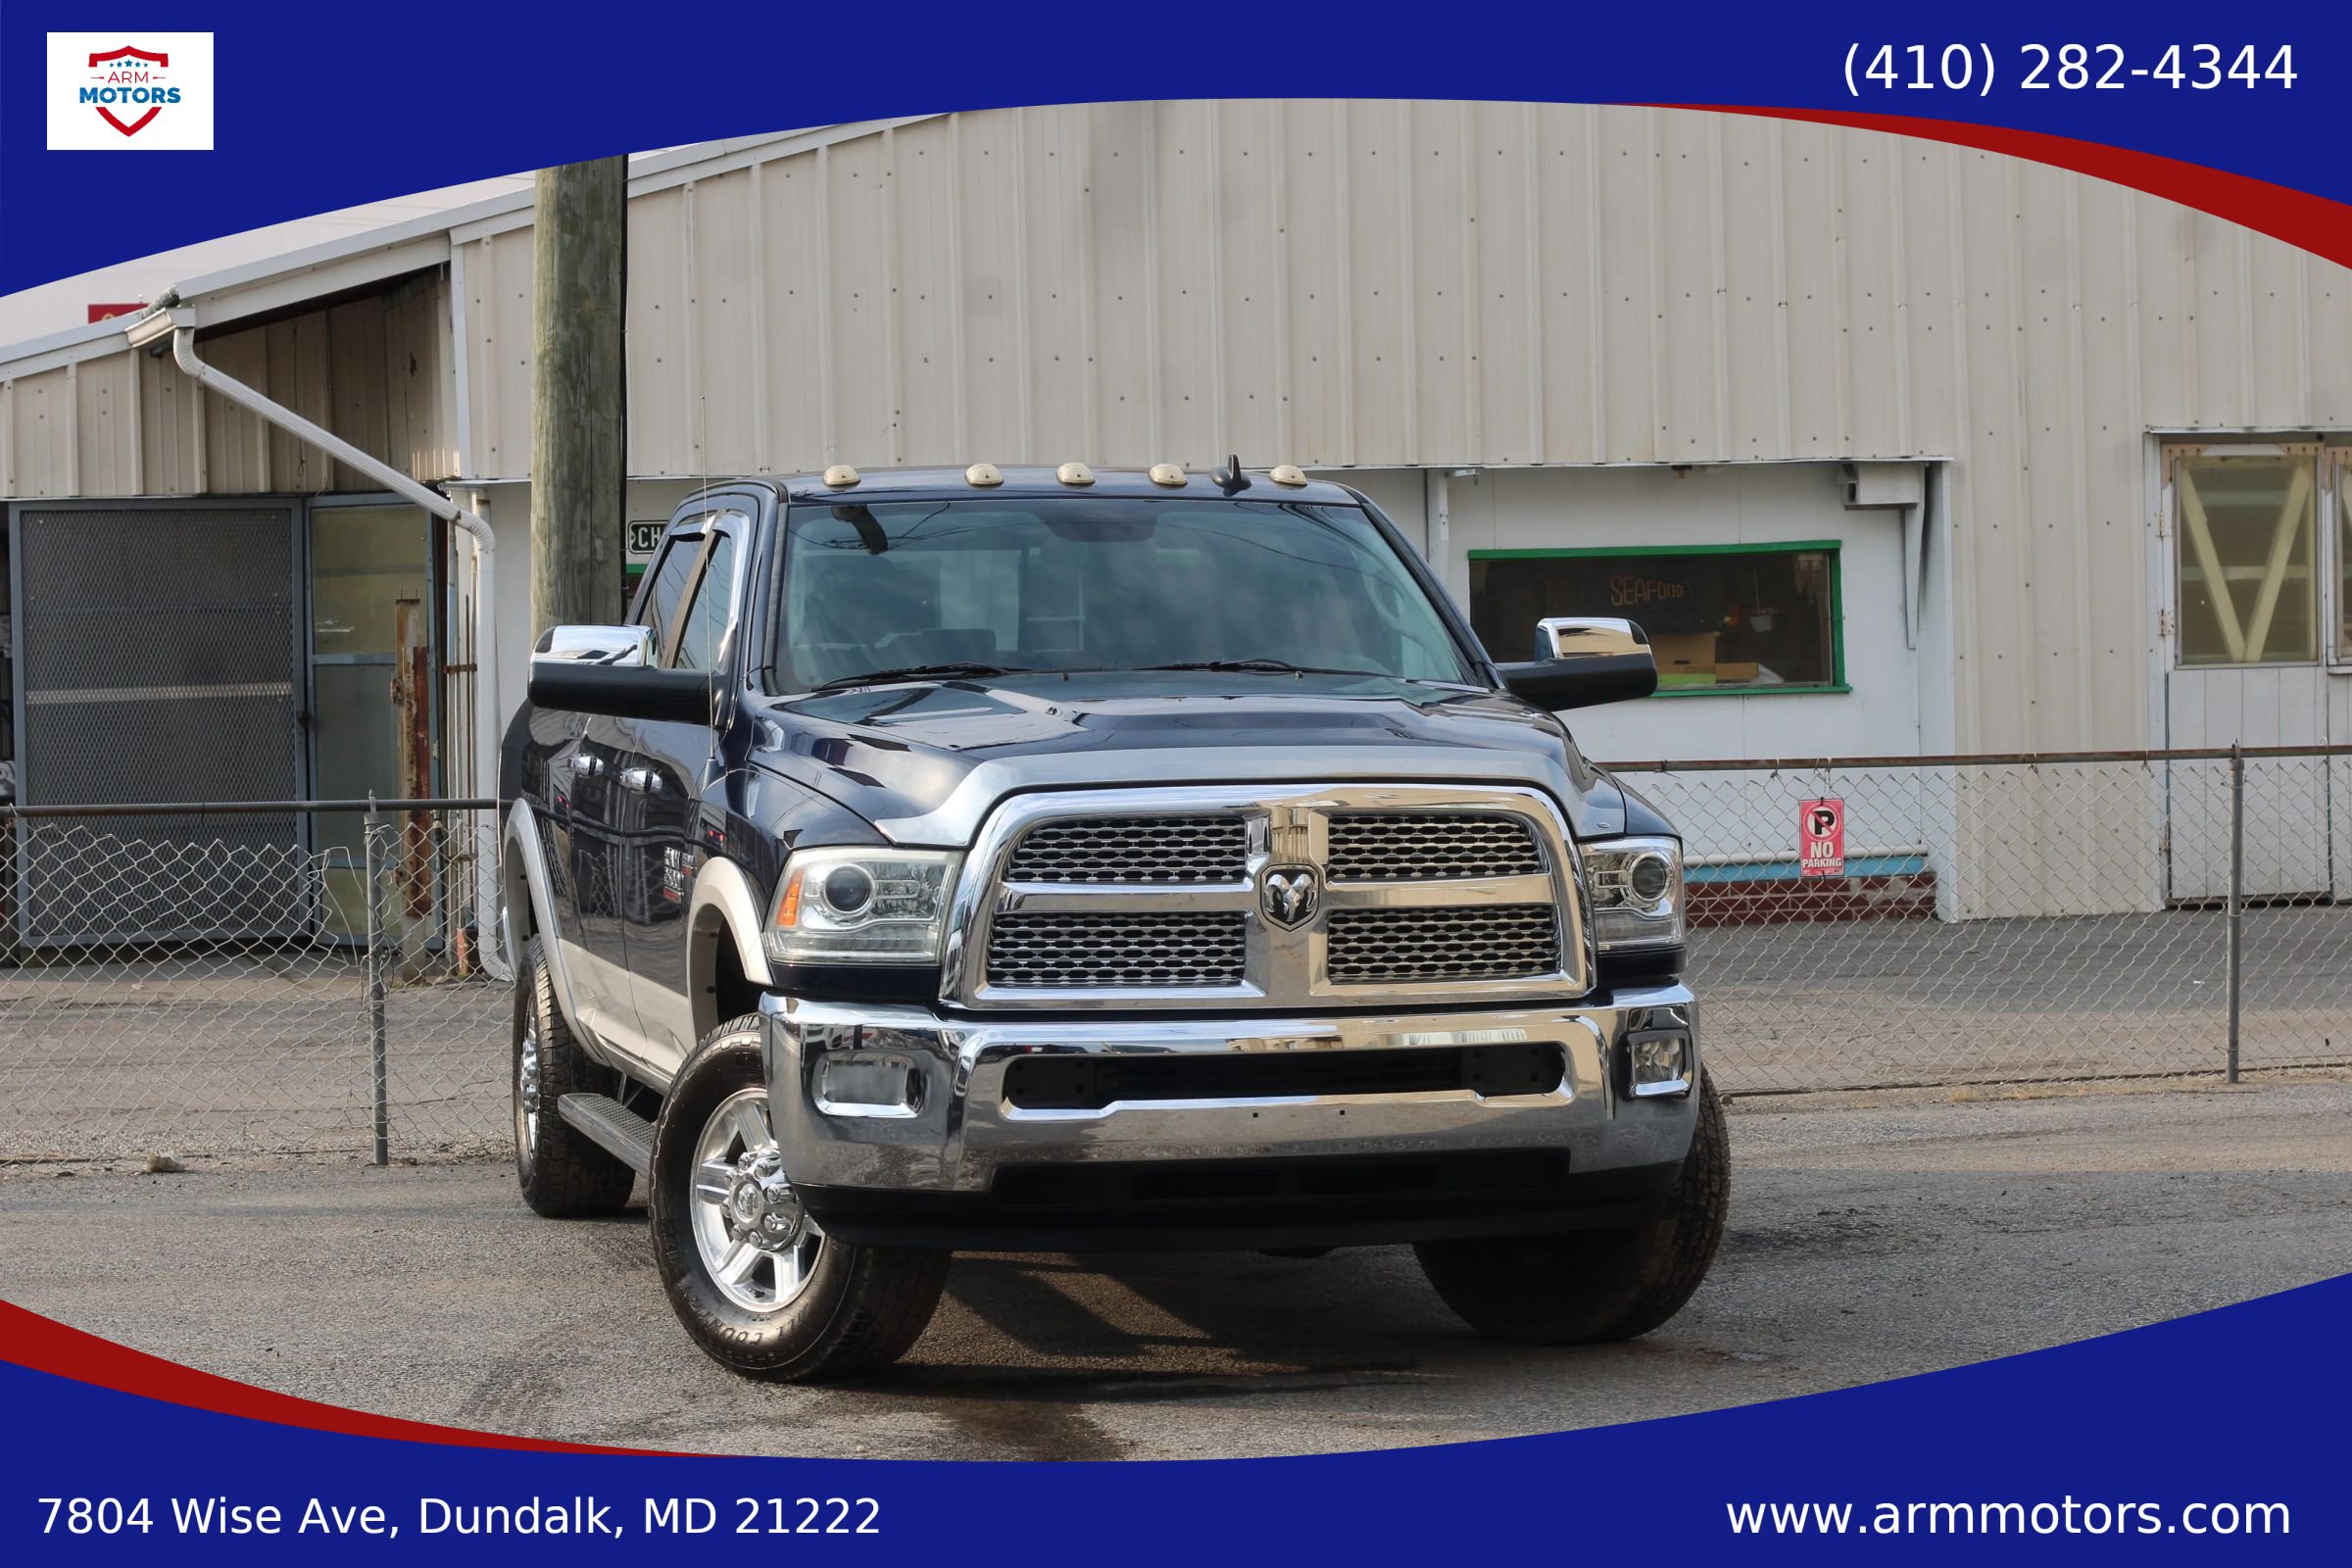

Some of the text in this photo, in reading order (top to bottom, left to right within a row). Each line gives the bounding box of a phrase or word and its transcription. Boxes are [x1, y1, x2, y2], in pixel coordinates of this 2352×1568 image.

[1610, 575, 1684, 606] SEAFOOD
[1810, 841, 1834, 858] NO
[1802, 858, 1842, 868] PARKING
